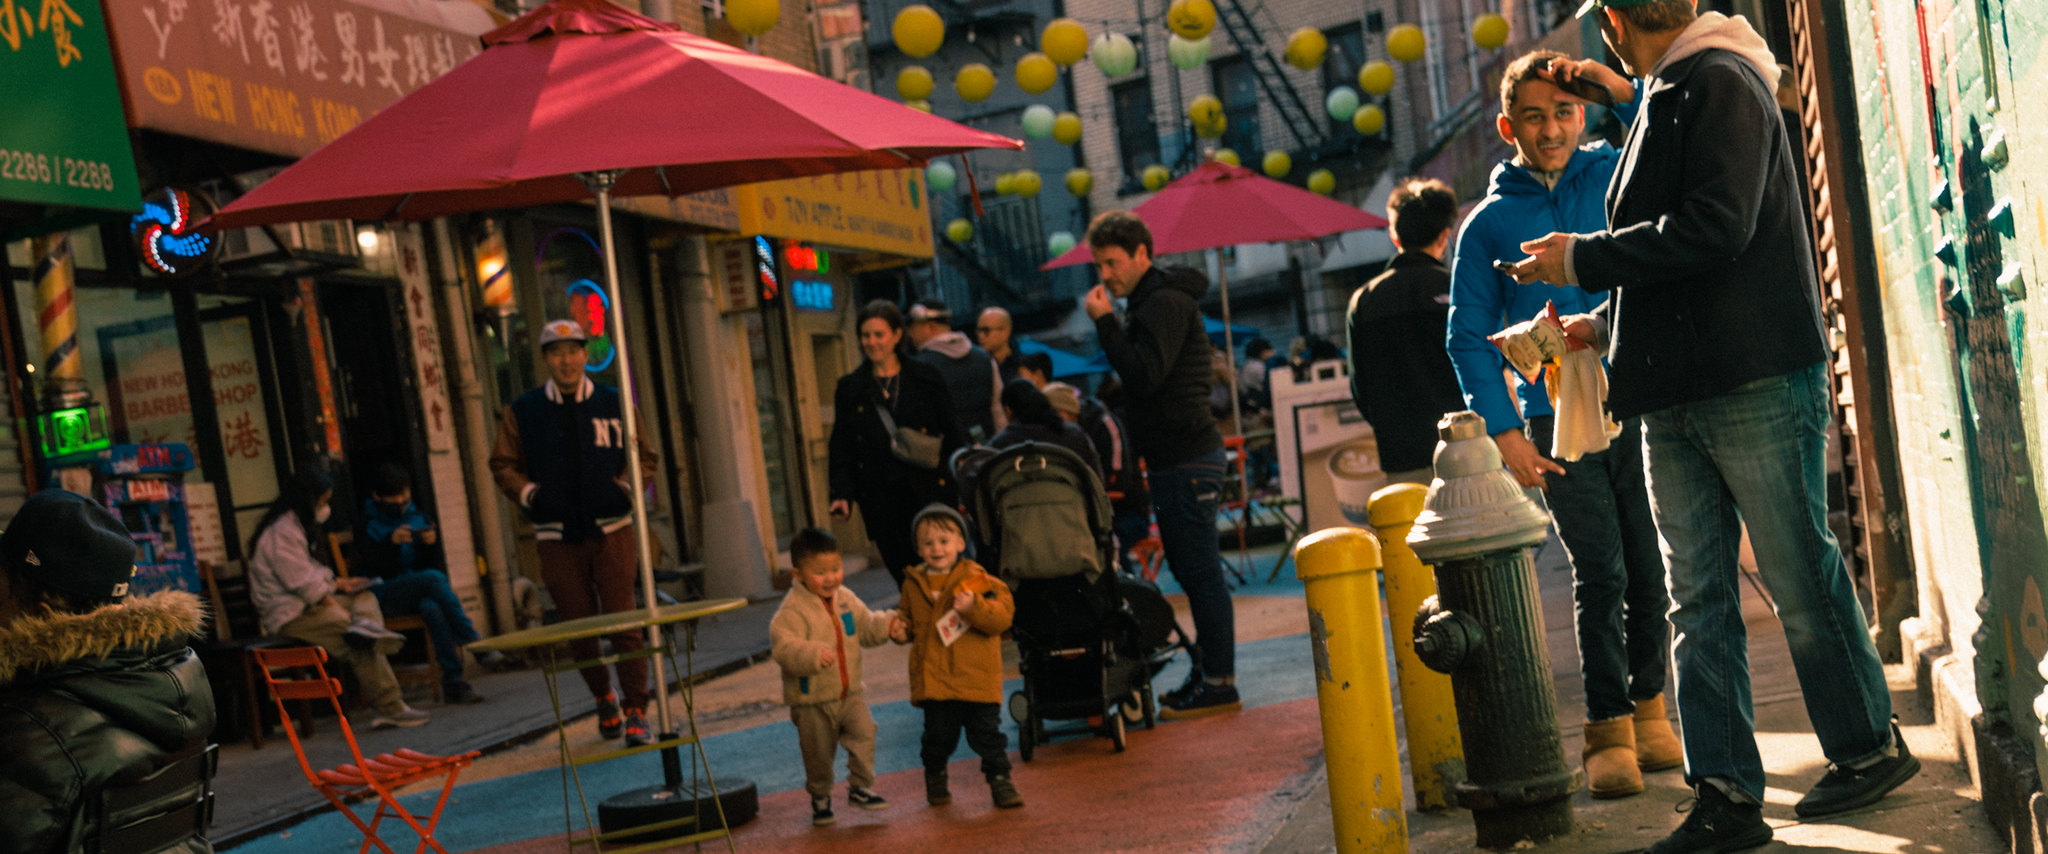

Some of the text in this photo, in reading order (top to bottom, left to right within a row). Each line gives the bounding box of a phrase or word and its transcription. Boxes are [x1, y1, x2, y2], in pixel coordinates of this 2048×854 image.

[186, 66, 237, 126] NEW
[245, 81, 306, 139] HONG
[123, 375, 157, 393] NEW
[127, 393, 192, 421] BARBE
[591, 417, 623, 449] NY
[137, 445, 173, 468] ATM
